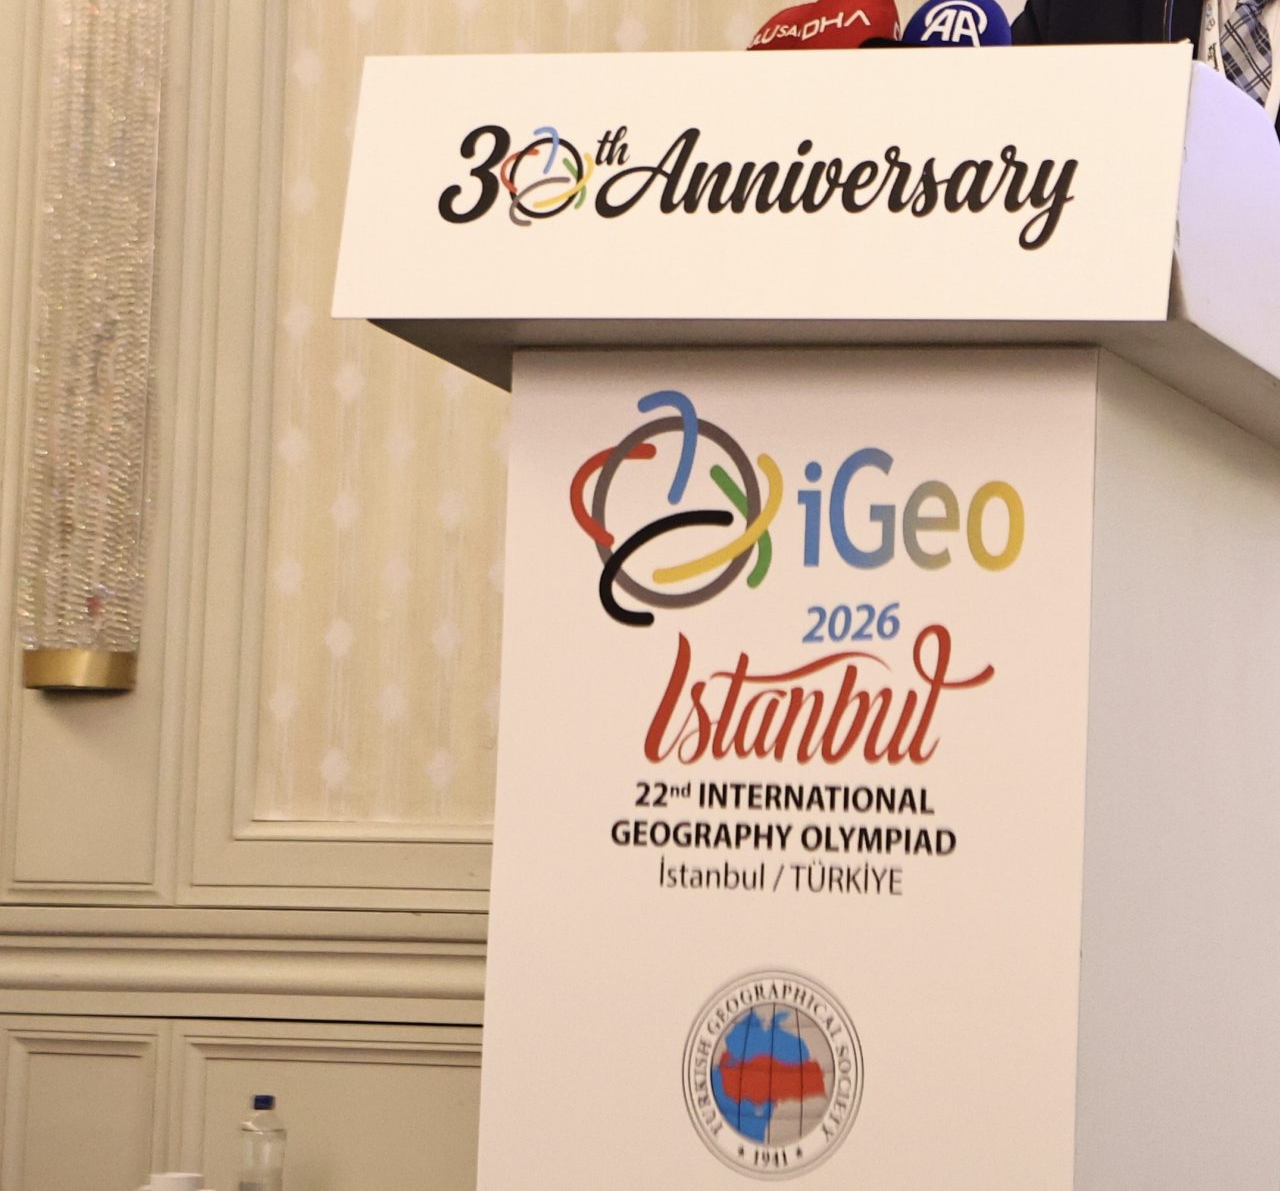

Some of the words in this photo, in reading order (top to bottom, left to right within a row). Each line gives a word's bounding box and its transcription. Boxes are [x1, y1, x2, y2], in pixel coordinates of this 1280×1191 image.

[595, 127, 1079, 251] Anniversary
[797, 447, 1025, 572] iGeo
[801, 602, 901, 644] 2026
[634, 781, 691, 809] 22nd
[698, 782, 935, 816] INTERNATIONAL
[610, 818, 793, 853] GEOGRAPHY
[800, 824, 957, 857] OLYMPIAD
[659, 854, 765, 891] İstanbul
[790, 858, 903, 896] TÜRKİYE
[707, 981, 843, 1040] GEOGRAPHICAL
[820, 1043, 852, 1143] SOCIETY
[753, 1150, 789, 1168] 1941
